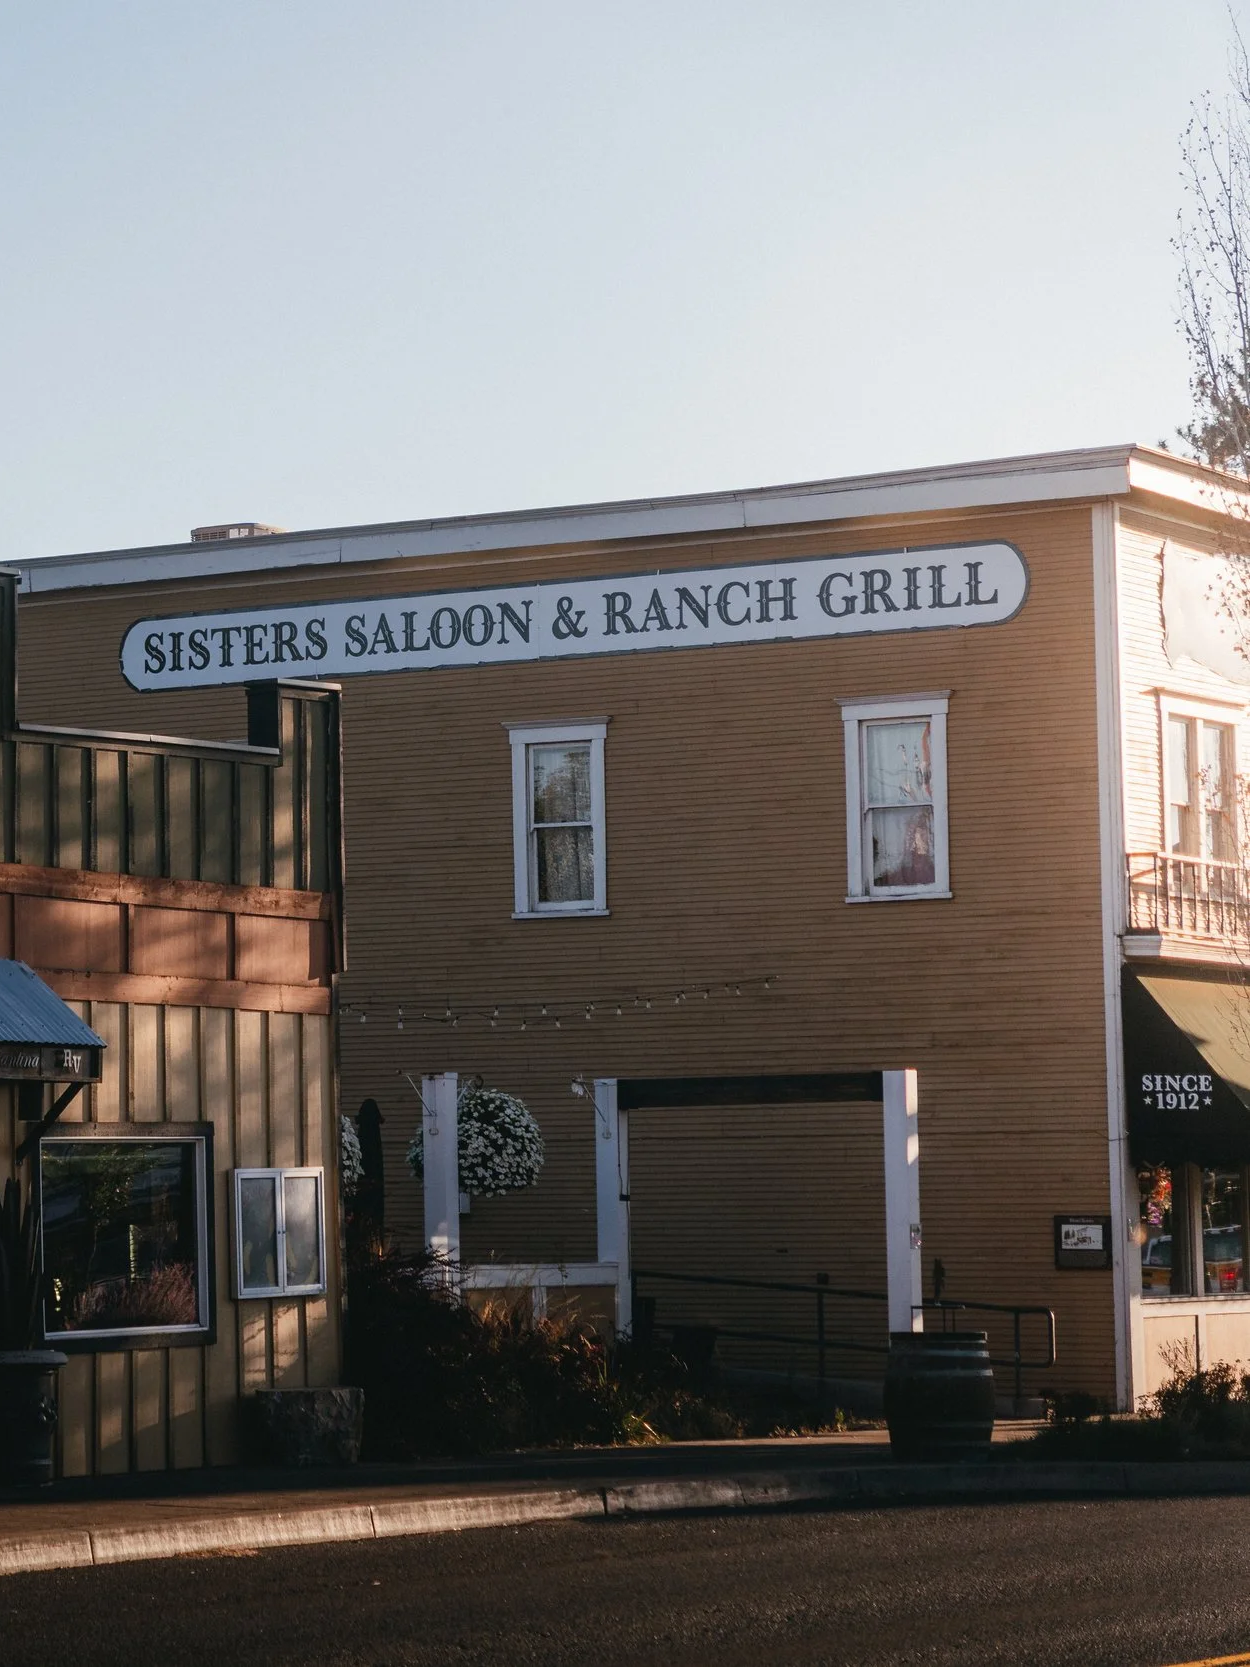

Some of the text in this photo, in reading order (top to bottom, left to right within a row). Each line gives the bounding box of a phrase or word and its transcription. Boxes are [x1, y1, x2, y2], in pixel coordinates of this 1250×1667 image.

[144, 561, 998, 675] SISTERS SALOON & RANCH GRILL
[1142, 1074, 1213, 1092] SINCE
[1156, 1093, 1200, 1110] 1912
